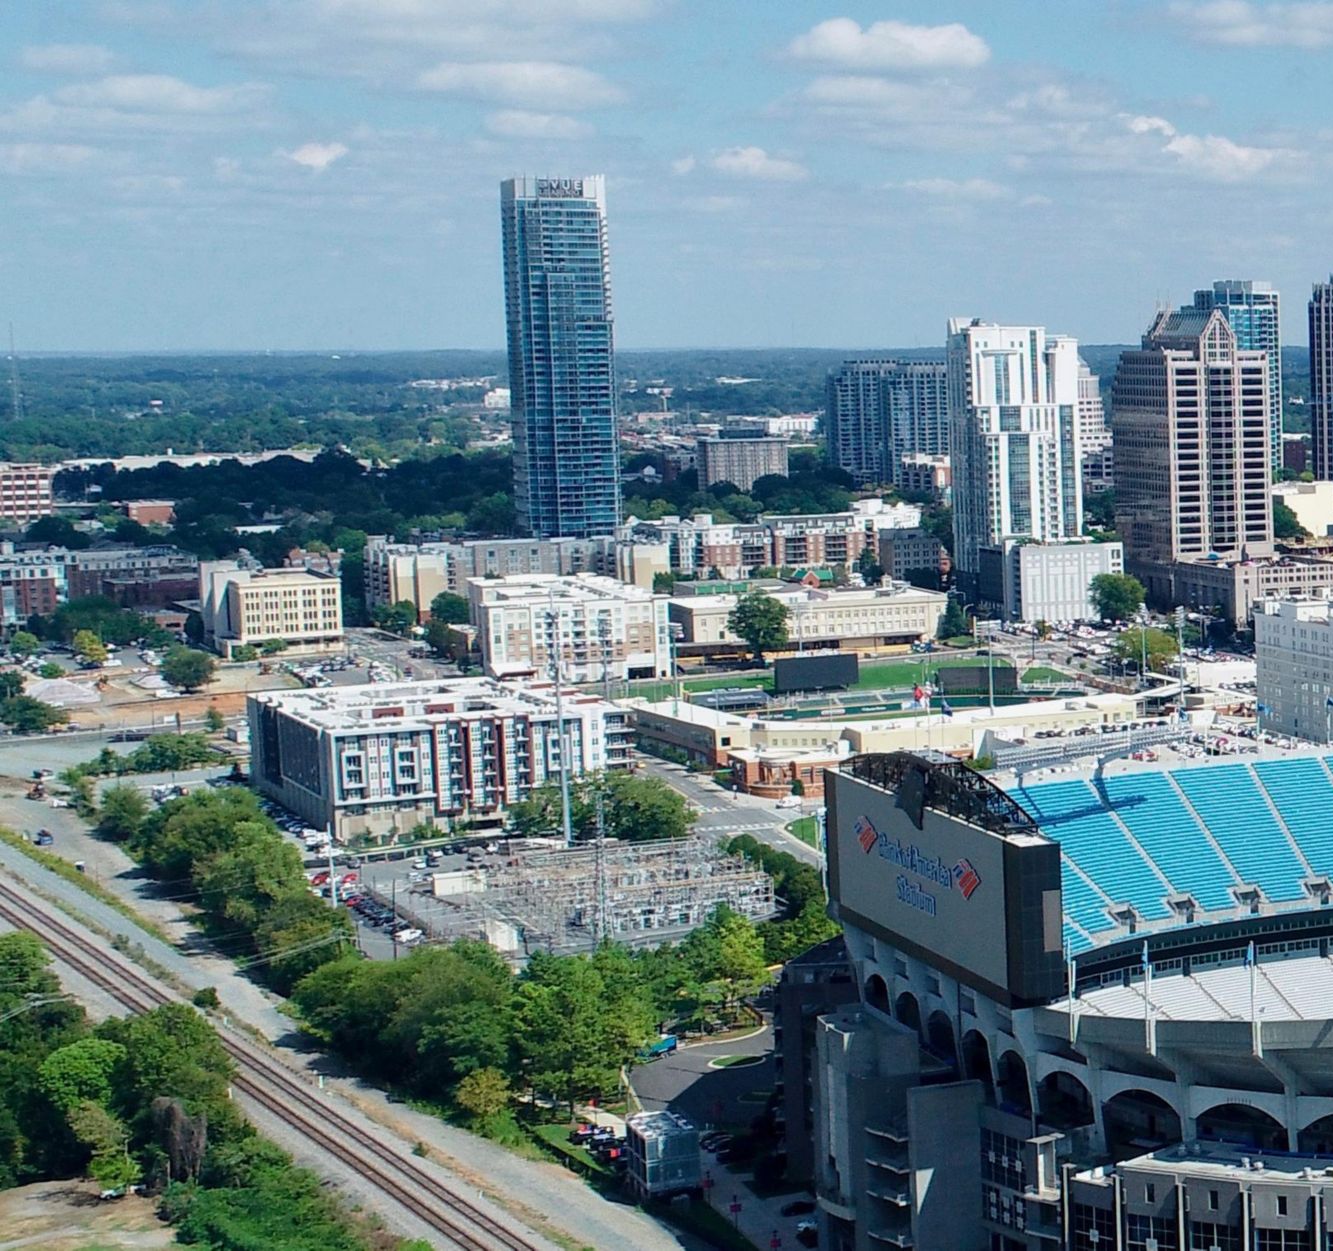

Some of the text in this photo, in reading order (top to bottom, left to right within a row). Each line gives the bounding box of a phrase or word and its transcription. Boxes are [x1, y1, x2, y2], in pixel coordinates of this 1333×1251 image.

[878, 831, 903, 866] Bank
[911, 846, 952, 889] America
[896, 873, 936, 918] Stadium
